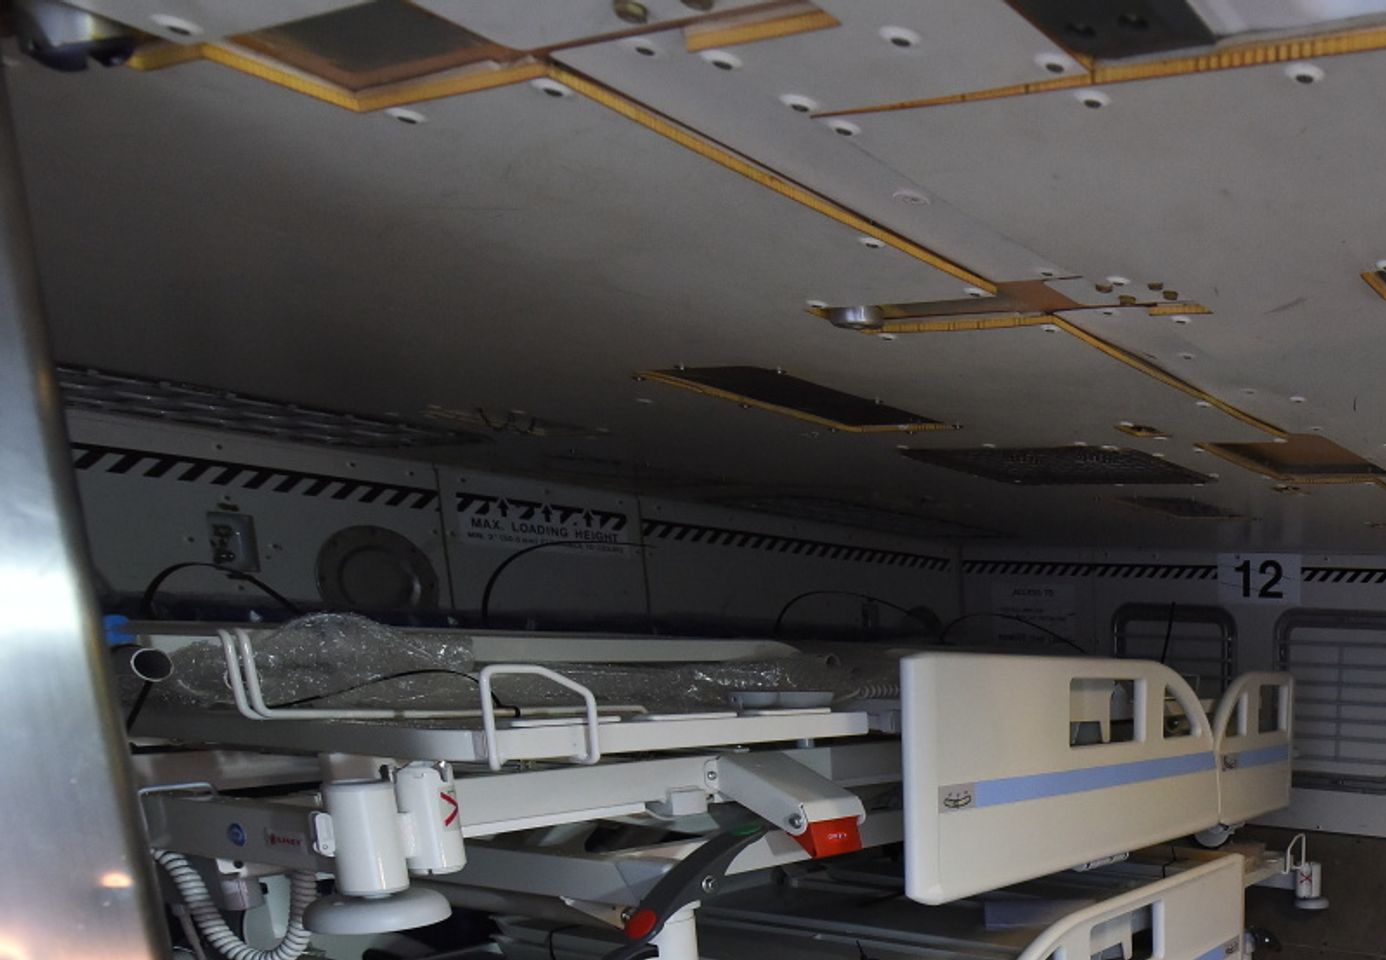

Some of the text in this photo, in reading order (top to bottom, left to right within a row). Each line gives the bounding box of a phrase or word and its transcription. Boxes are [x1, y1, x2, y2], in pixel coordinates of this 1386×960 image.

[471, 517, 504, 531] MAX.
[511, 521, 569, 538] LOADING
[575, 529, 619, 543] HEIGHT
[1234, 559, 1284, 598] 12
